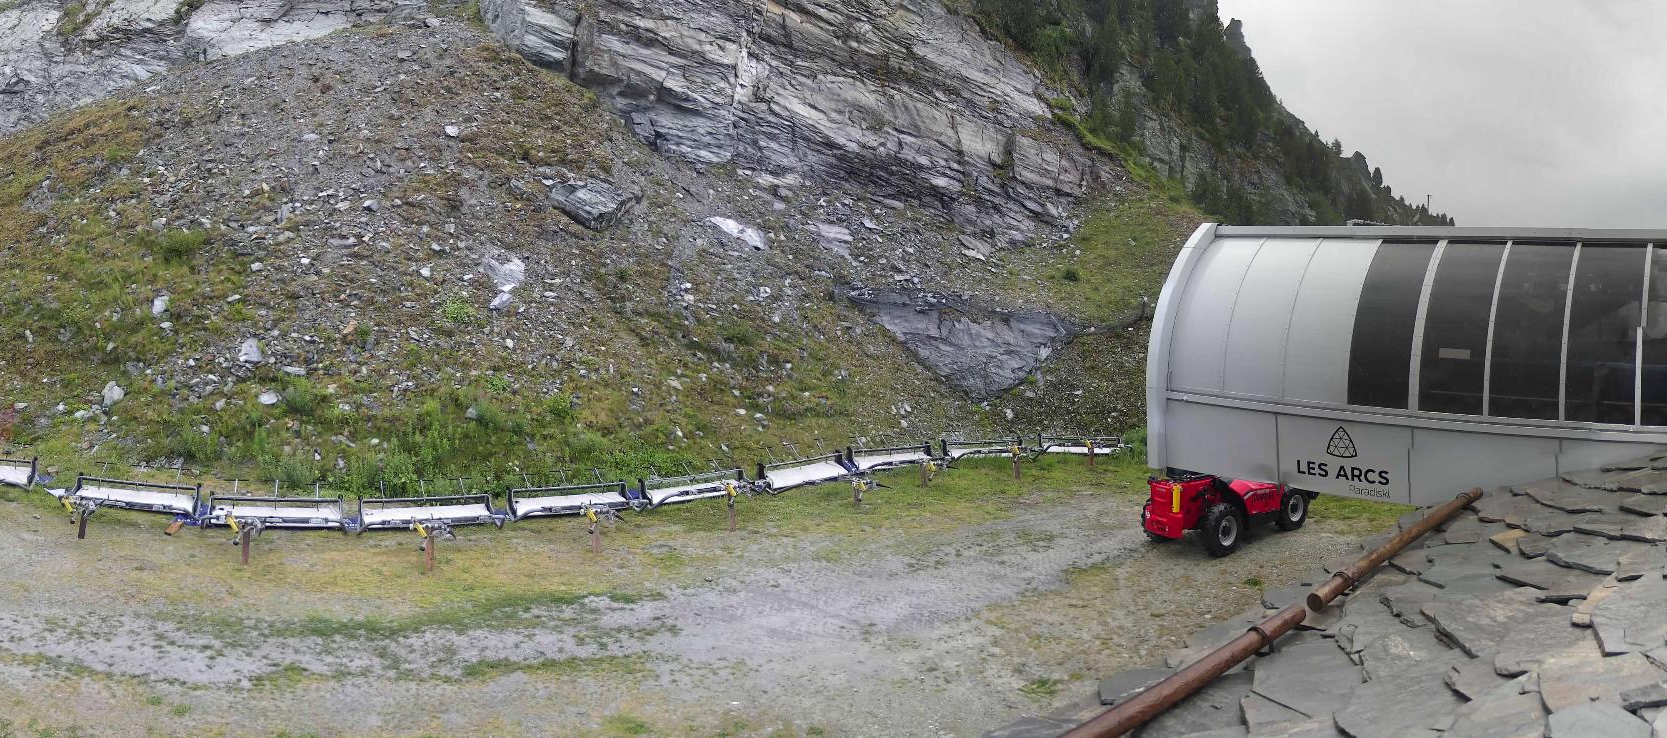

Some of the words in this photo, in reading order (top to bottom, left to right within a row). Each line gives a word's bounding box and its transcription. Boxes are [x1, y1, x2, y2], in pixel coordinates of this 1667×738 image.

[1296, 459, 1329, 478] LES
[1335, 465, 1390, 486] ARCS
[1348, 484, 1391, 499] Paradiski
